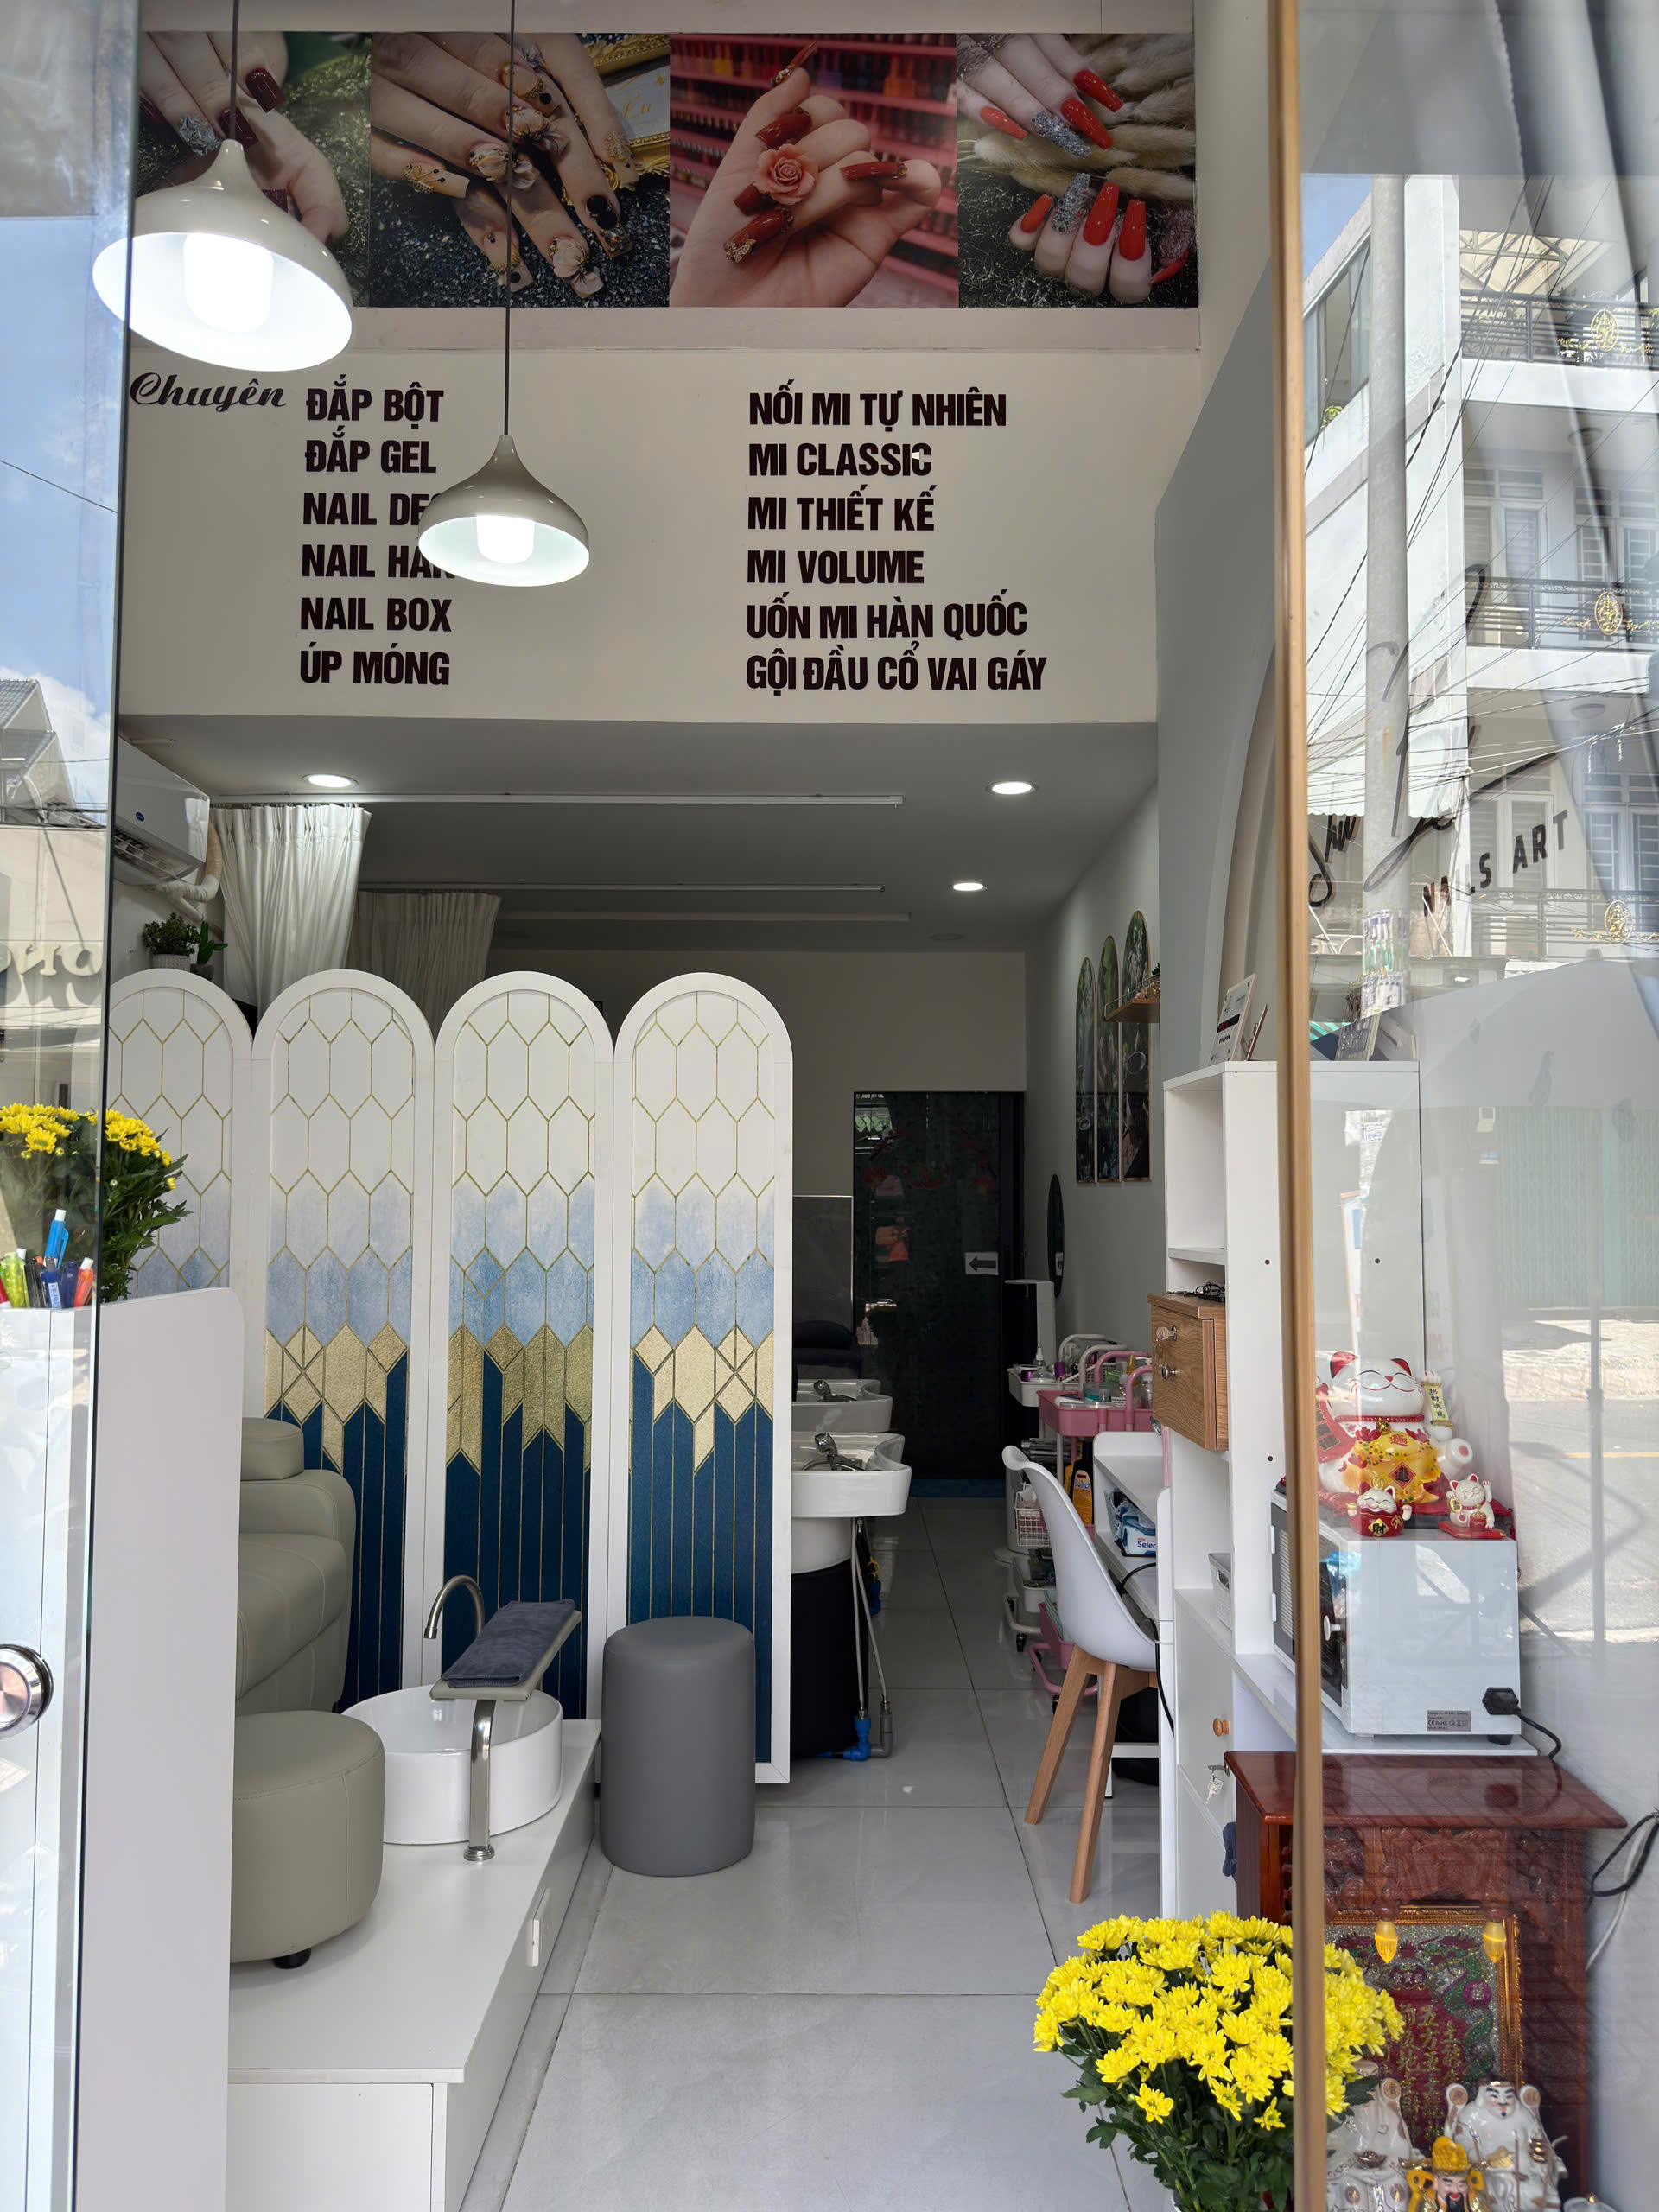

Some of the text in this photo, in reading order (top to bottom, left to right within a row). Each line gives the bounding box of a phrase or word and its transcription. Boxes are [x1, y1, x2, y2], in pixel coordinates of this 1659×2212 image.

[130, 372, 287, 413] Chuyên
[305, 373, 444, 430] ĐẮP BỘT
[749, 378, 1007, 433] NỐI MI TỰ NHIÊN
[304, 424, 437, 474] ĐẮP GEL
[748, 442, 932, 477] MI CLASSIC
[302, 492, 378, 526] NAIL
[747, 484, 938, 531] MI THIẾT KẾ
[302, 543, 376, 578] NAIL
[747, 550, 925, 585] MI VOLUME
[300, 597, 453, 632] NAIL BOX
[747, 588, 1027, 641] UỐN MI HÀN QUỐC
[300, 641, 450, 686] ÚP MÓNG
[747, 640, 1047, 696] GỘI ĐẦU CỔ VAI GÁY
[1511, 810, 1568, 874] ART
